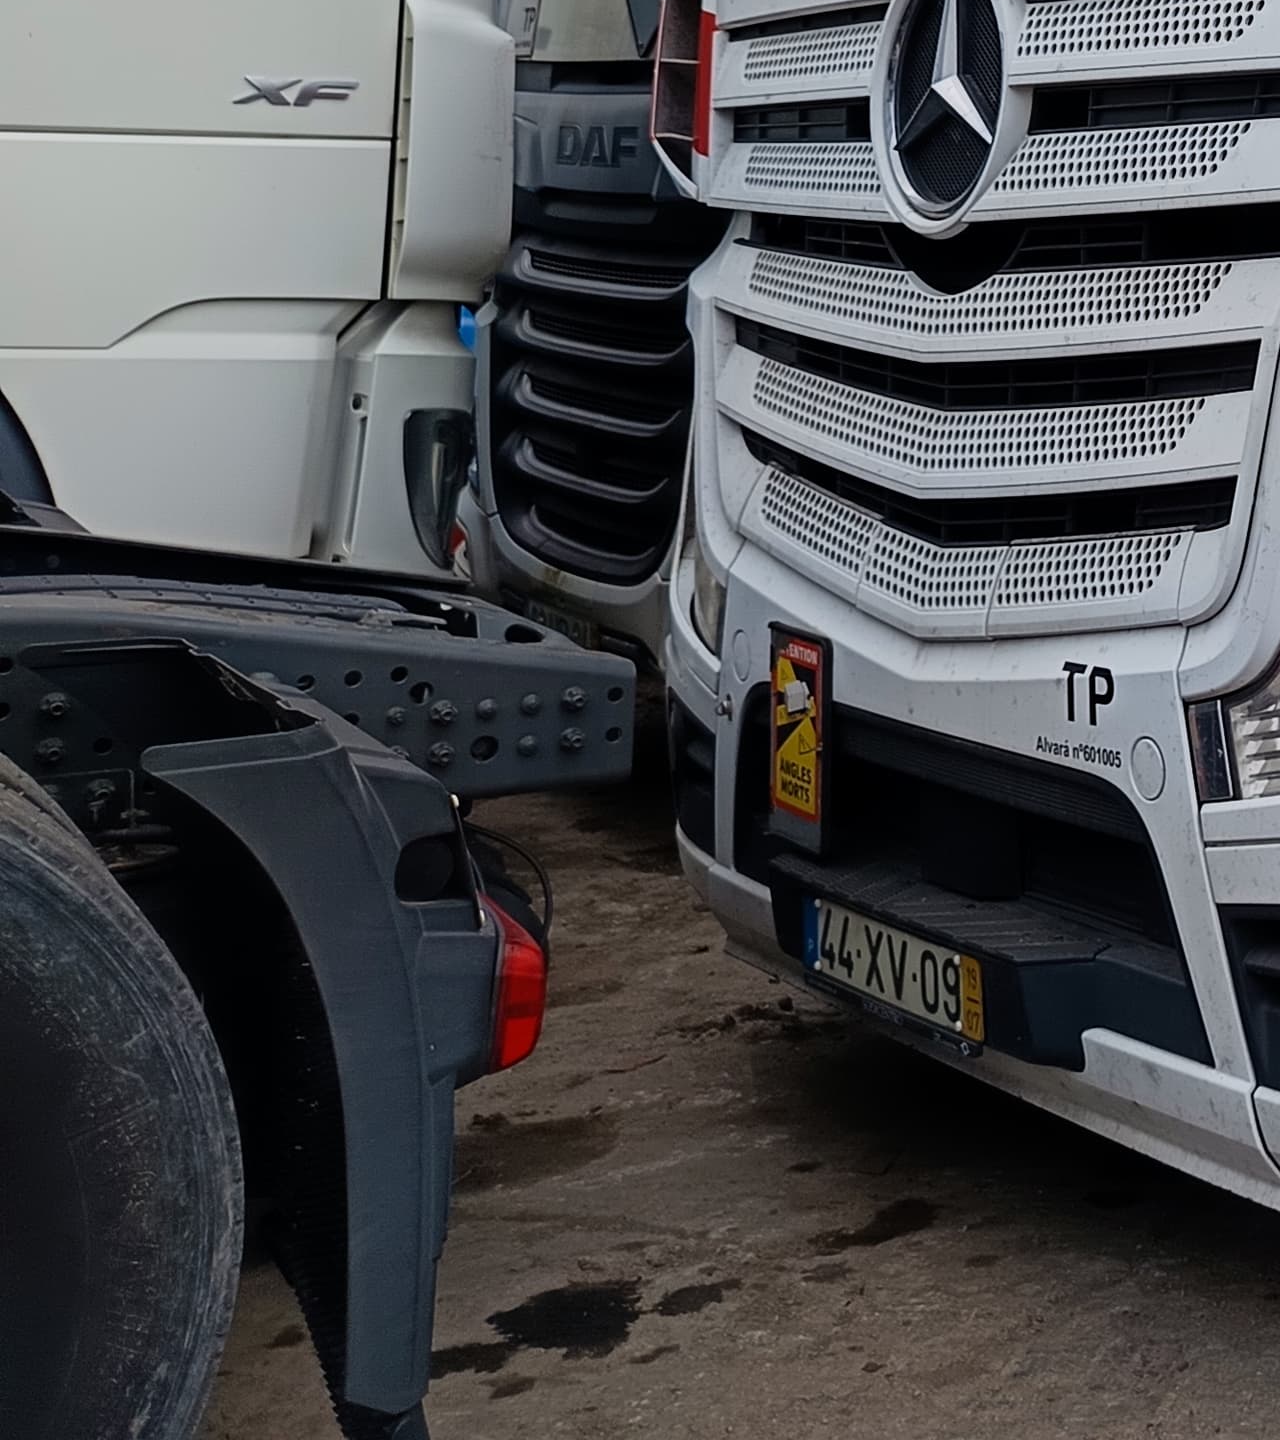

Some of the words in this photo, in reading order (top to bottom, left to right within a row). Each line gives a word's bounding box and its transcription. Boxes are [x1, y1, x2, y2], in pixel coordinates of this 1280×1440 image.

[231, 75, 361, 107] XF
[555, 124, 641, 168] DAF
[1062, 661, 1115, 726] TP
[1036, 735, 1070, 758] Alvará
[779, 757, 812, 785] ANGLES
[780, 779, 810, 804] MORTS
[820, 907, 962, 1023] 44-XV-09
